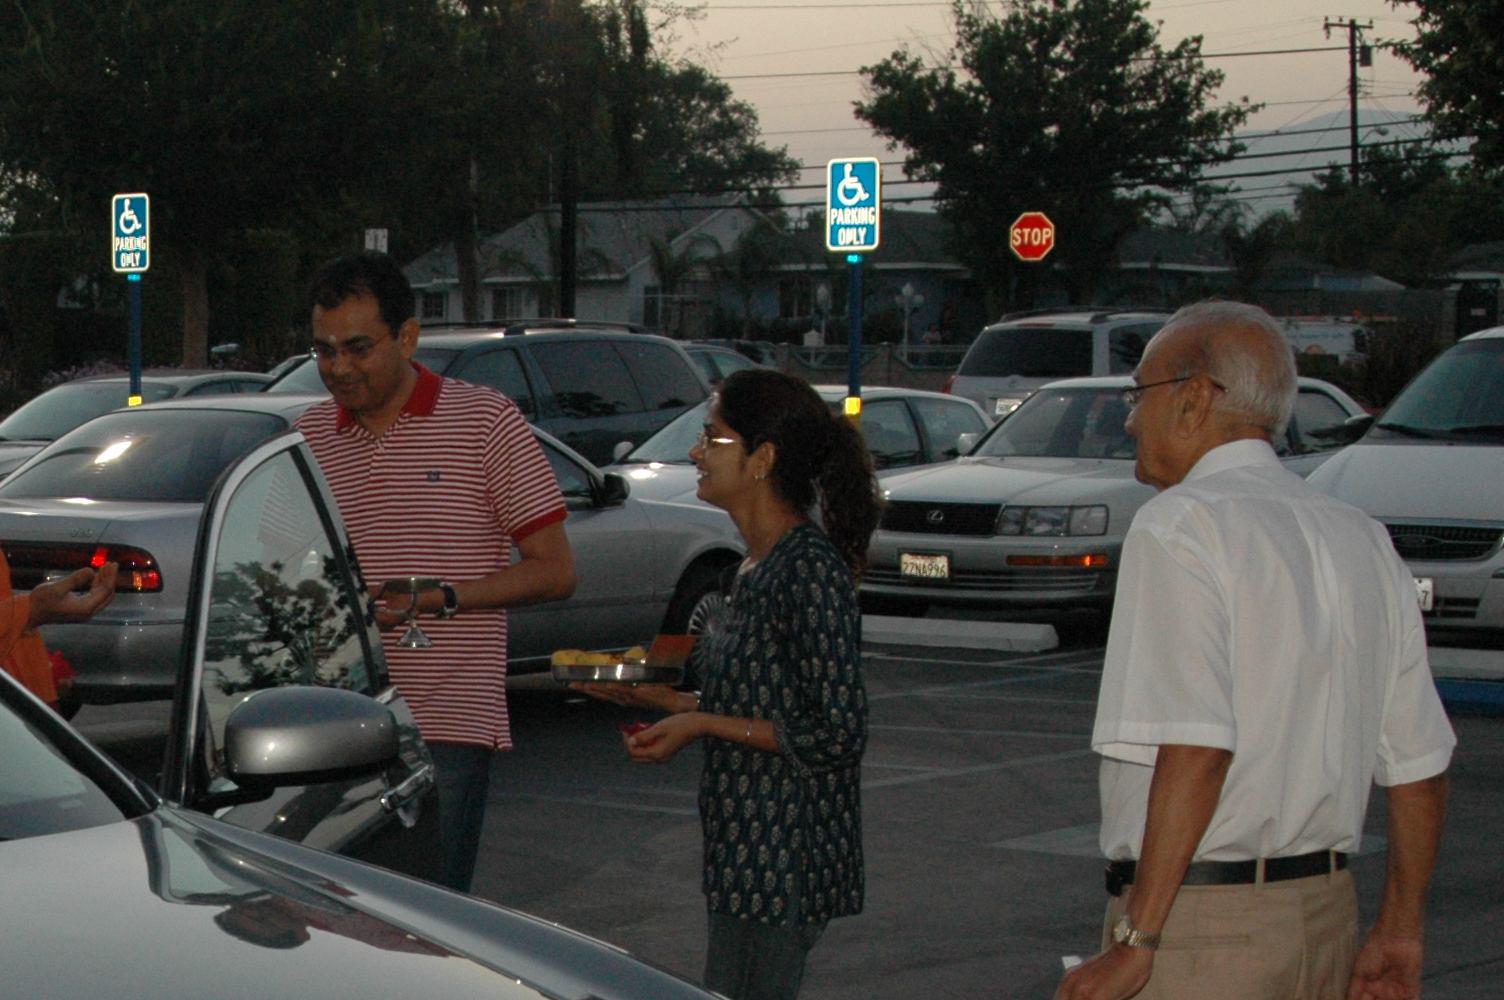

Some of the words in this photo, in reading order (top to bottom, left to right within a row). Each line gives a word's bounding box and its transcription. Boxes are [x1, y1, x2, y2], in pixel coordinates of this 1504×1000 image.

[831, 206, 876, 226] PARKING
[115, 236, 147, 252] PARKING
[838, 227, 867, 246] ONLY
[1012, 228, 1052, 246] STOP
[120, 252, 142, 268] ONLY
